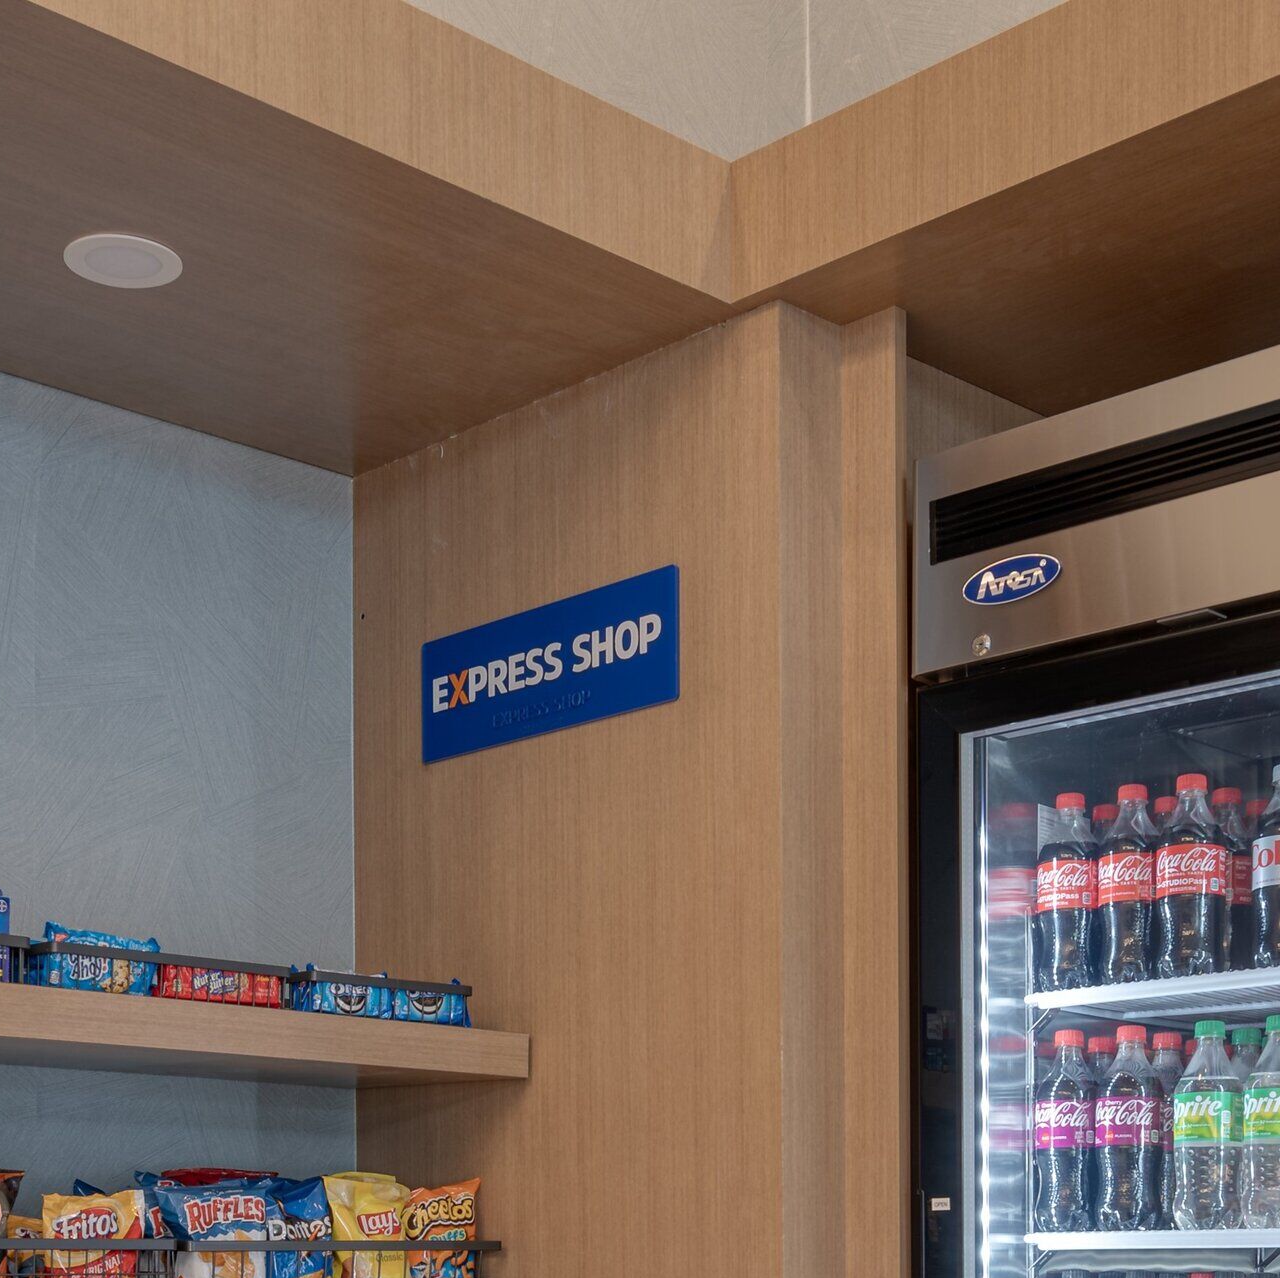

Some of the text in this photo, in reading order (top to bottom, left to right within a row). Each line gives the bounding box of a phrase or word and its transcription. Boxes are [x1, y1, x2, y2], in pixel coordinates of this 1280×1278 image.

[433, 614, 662, 713] EXPRESS SHOP
[1157, 848, 1218, 876] Coca-Cola
[54, 1210, 119, 1239] Fritos
[187, 1197, 267, 1235] RUFFLES
[361, 1209, 398, 1235] Lay's
[403, 1197, 474, 1234] Cheetos
